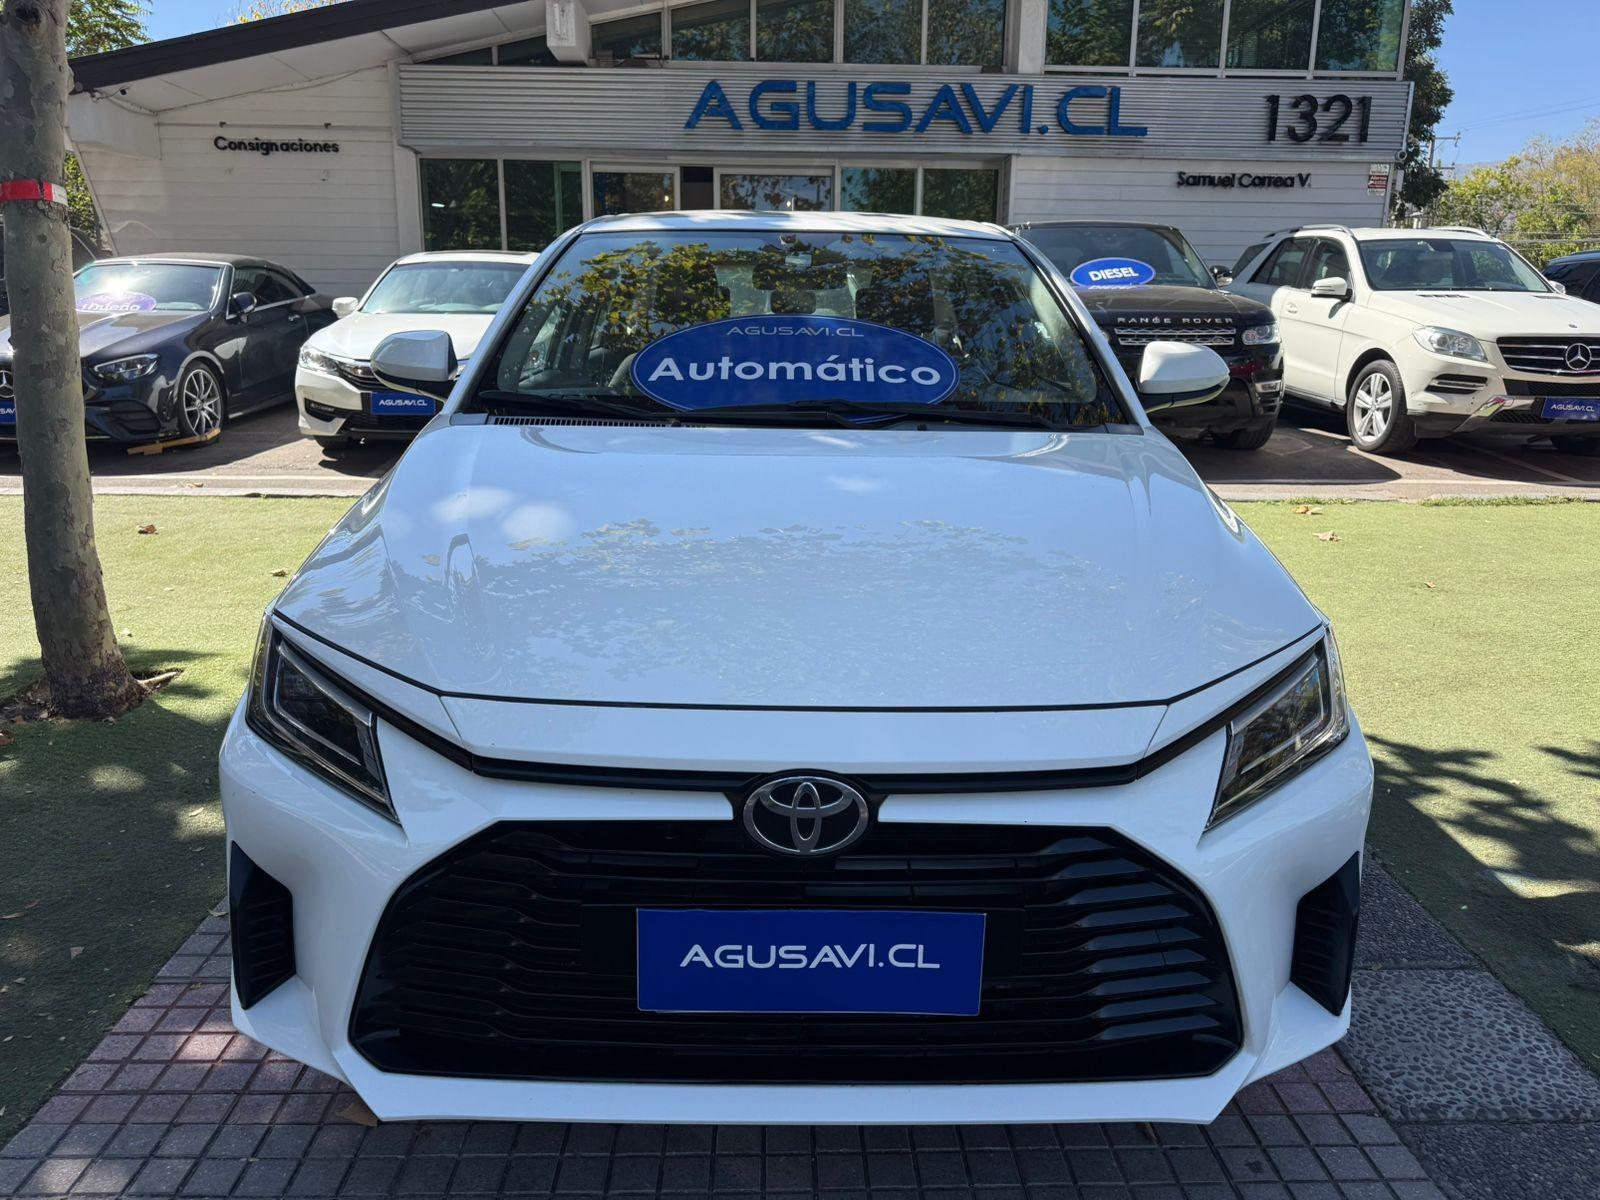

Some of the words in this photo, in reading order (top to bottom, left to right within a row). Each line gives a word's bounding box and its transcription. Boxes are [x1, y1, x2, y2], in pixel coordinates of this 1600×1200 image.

[685, 79, 1148, 137] AGUSAVI.CL
[1263, 94, 1373, 143] 1321
[213, 136, 340, 156] Consignaciones
[1177, 171, 1236, 188] Samuel
[1238, 173, 1295, 188] Correa
[1088, 266, 1140, 282] DIESEL
[1117, 316, 1172, 325] RANGE
[726, 326, 864, 338] AGUSAVI.CL
[648, 354, 941, 386] Automático
[379, 399, 428, 407] AGUSAVI.CL
[1550, 403, 1595, 412] AGUSAVI.CL
[680, 943, 941, 969] AGUSAVI.CL
